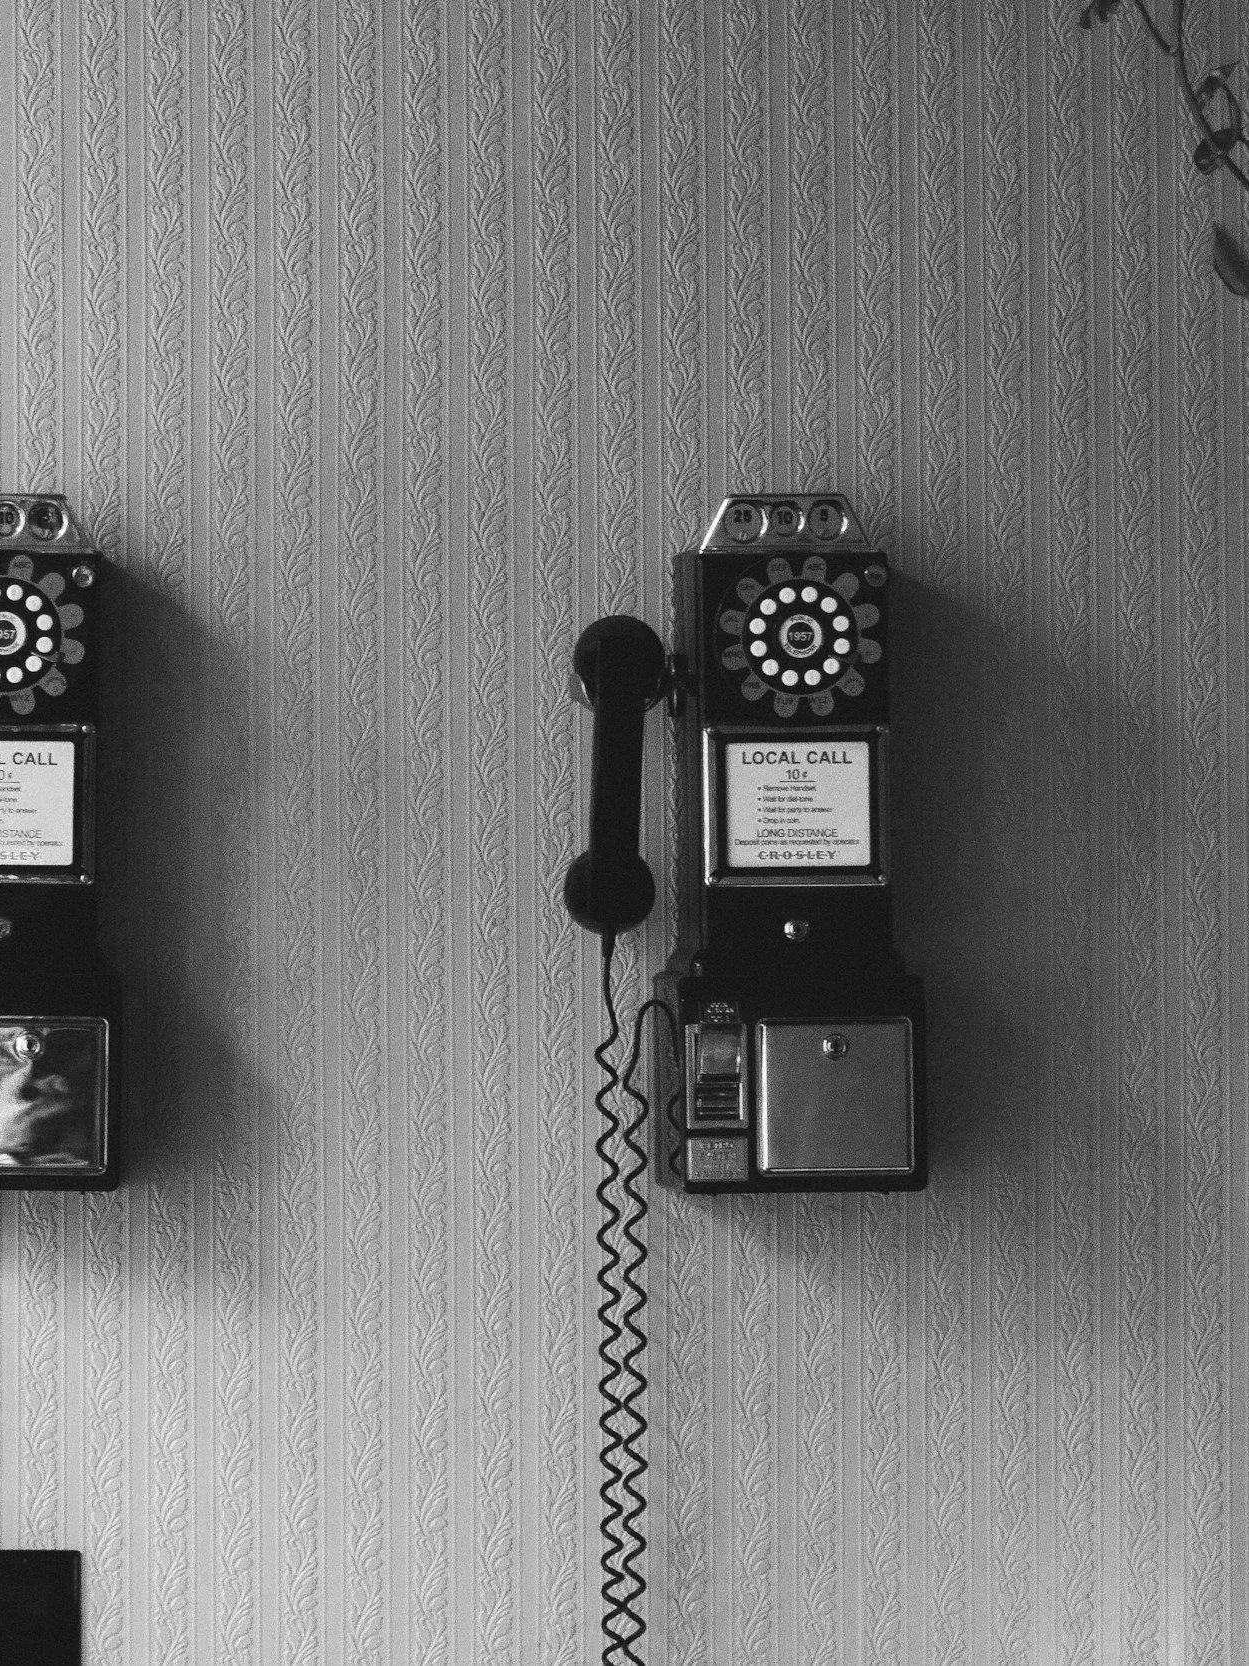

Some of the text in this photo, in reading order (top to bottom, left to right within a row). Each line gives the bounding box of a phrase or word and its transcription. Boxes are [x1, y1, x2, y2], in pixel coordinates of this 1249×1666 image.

[734, 510, 752, 523] 25
[777, 512, 793, 524] 10
[820, 509, 829, 522] 5
[788, 631, 813, 641] 1957
[12, 752, 58, 766] CALL
[742, 751, 853, 765] LOCAL CALL
[757, 828, 839, 837] LONG DISTANCE
[758, 850, 837, 860] CROSLEY
